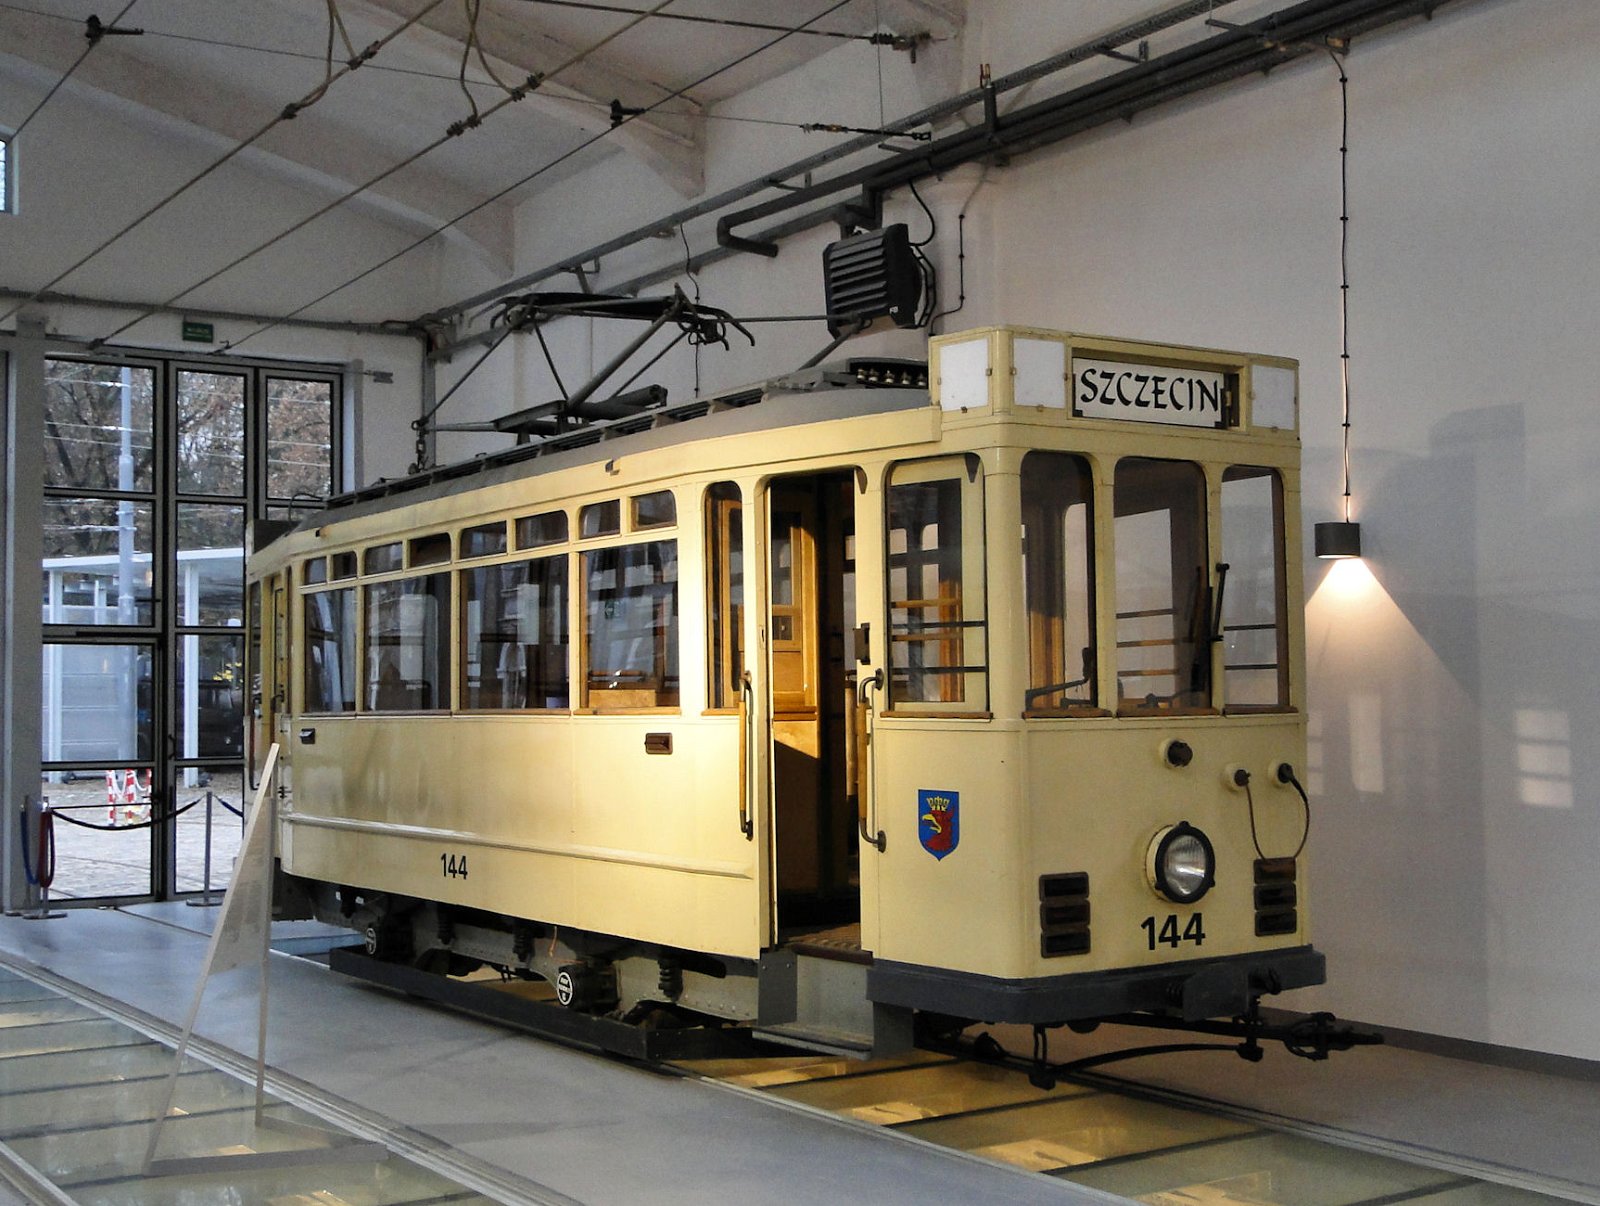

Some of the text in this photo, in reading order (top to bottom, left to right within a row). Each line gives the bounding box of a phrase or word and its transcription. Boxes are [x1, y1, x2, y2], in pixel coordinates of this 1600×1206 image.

[1080, 368, 1218, 412] SZCZECIN
[441, 853, 468, 880] 144
[1141, 912, 1206, 950] 144
